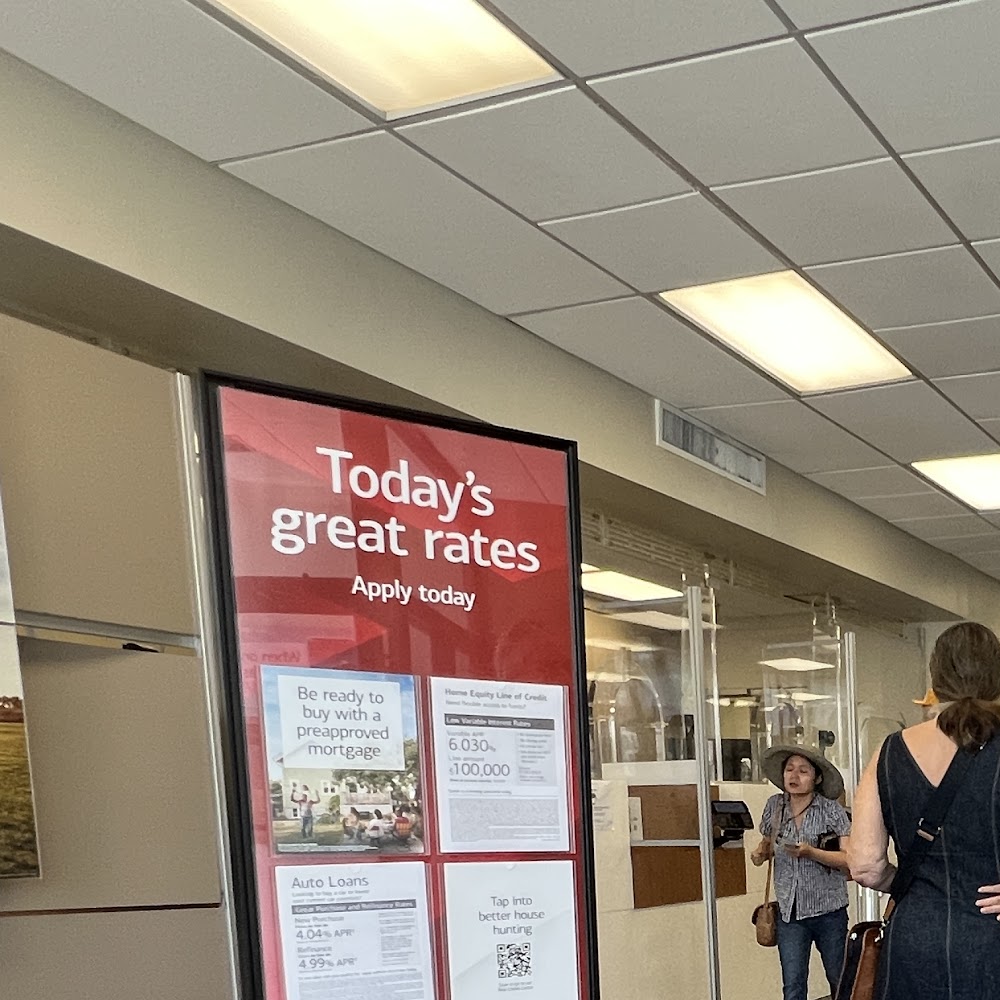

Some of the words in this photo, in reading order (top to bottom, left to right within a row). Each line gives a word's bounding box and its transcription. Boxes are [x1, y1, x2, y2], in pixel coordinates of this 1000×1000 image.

[316, 446, 494, 523] Today's
[271, 507, 409, 556] great
[425, 527, 540, 573] rates
[351, 575, 412, 605] Apply
[418, 582, 476, 611] today
[297, 686, 318, 701] Be
[323, 690, 364, 706] ready
[369, 692, 384, 704] to
[445, 688, 468, 696] Home
[470, 690, 494, 700] Equity
[496, 692, 512, 700] Line
[524, 693, 547, 702] Credit
[303, 705, 330, 723] buy
[335, 707, 367, 721] with
[372, 712, 381, 722] a
[297, 726, 389, 741] preapproved
[308, 744, 381, 760] mortgage
[291, 877, 325, 889] Auto
[328, 875, 369, 888] Loans
[490, 896, 509, 908] Tap
[512, 896, 533, 906] into
[478, 911, 511, 921] better
[514, 909, 545, 920] house
[493, 925, 533, 936] hunting
